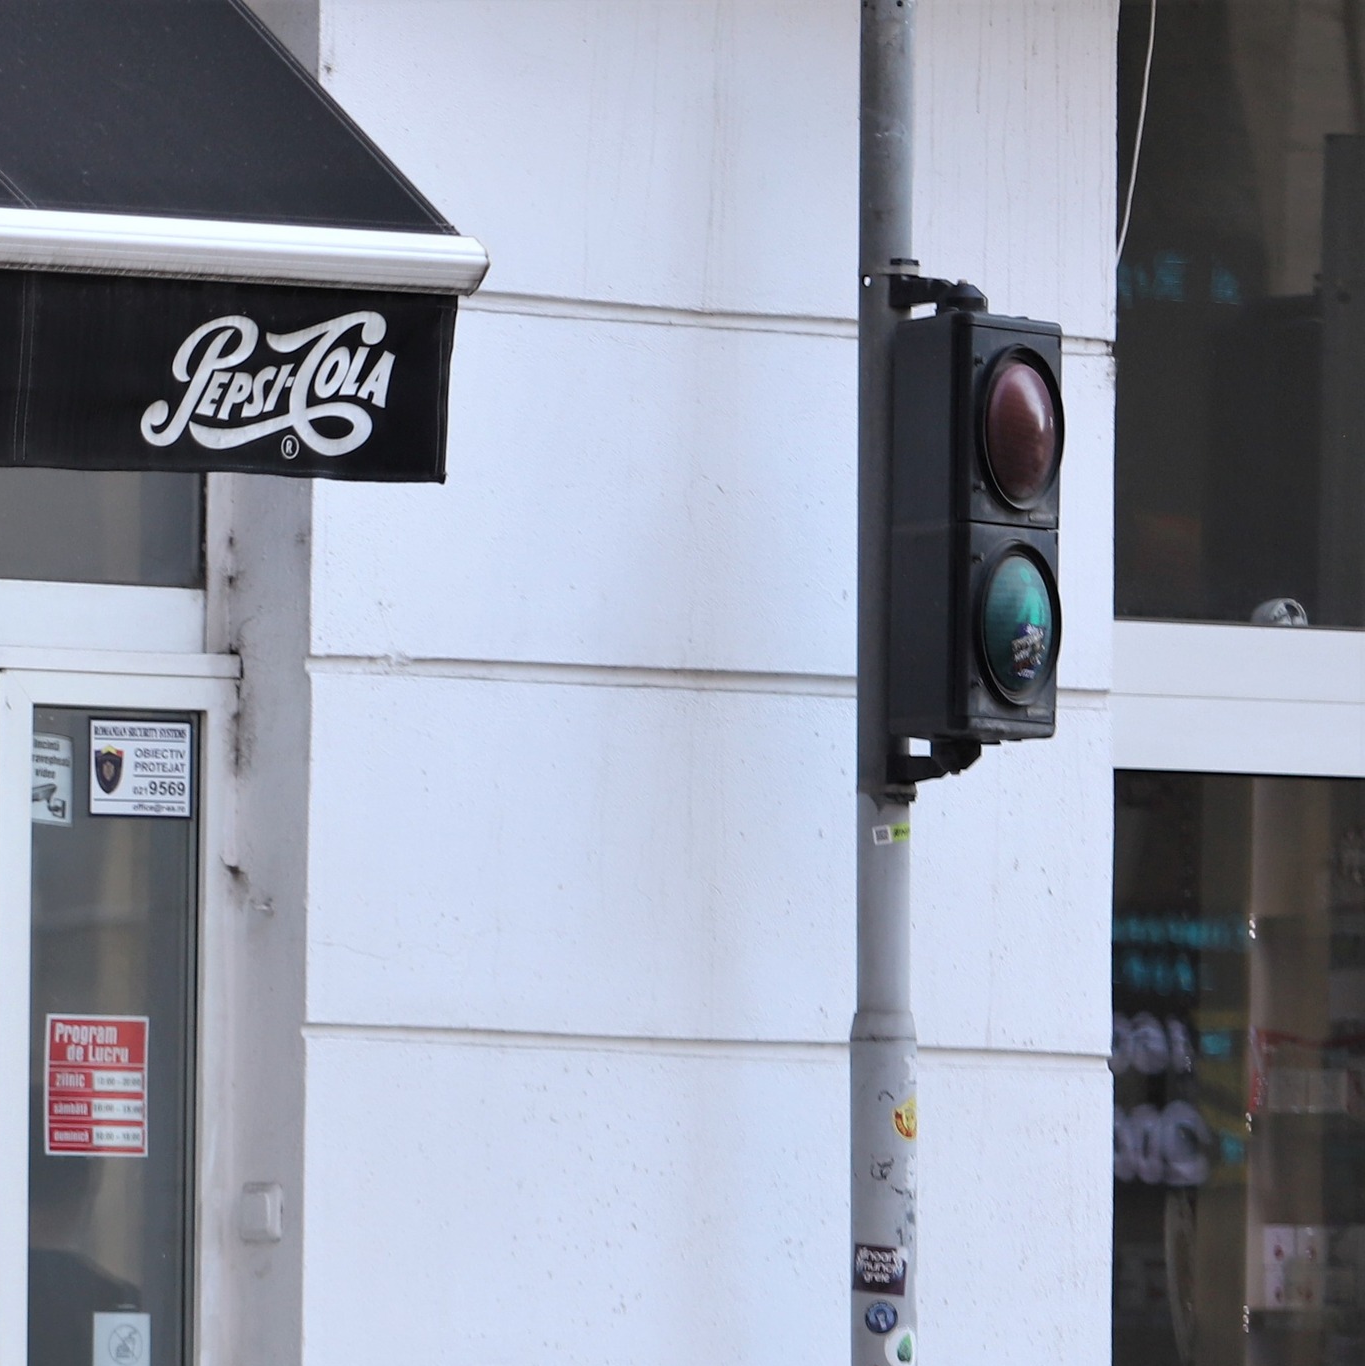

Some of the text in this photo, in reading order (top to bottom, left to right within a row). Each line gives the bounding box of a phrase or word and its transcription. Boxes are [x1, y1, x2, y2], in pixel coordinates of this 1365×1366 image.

[134, 748, 186, 760] OBIECTIV
[134, 761, 186, 774] PROTEJAT
[149, 781, 186, 797] 9569
[55, 1022, 118, 1046] Program
[66, 1044, 129, 1063] de Lucru
